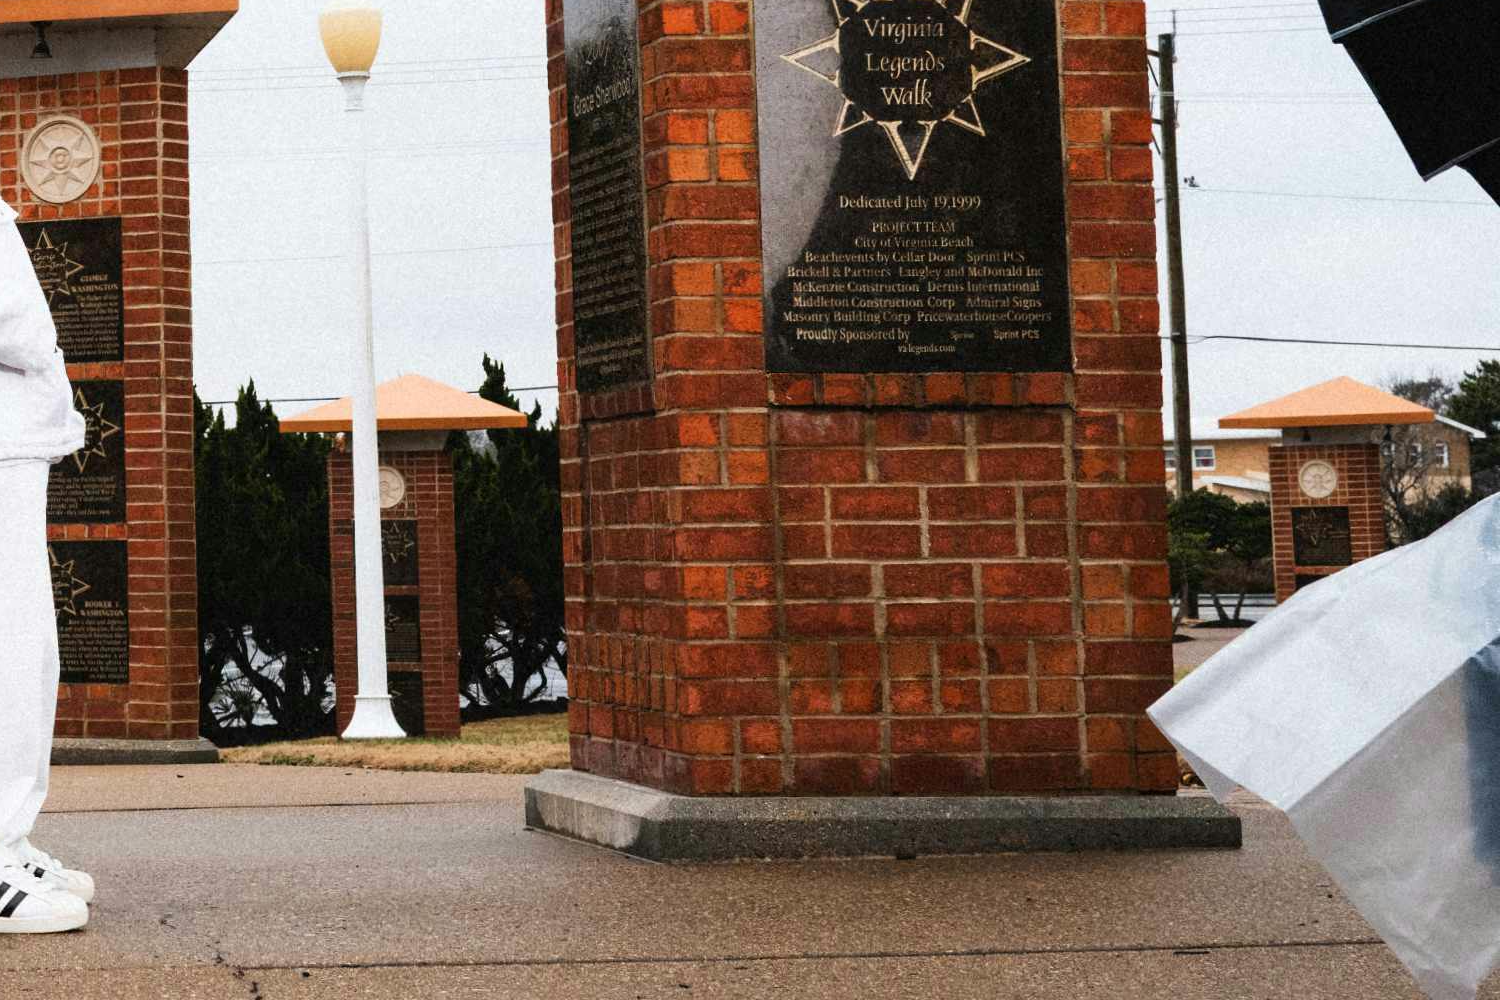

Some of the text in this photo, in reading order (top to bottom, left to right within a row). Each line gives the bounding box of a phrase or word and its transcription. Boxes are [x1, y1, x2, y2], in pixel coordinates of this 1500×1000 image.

[864, 16, 945, 45] Virginia
[865, 50, 946, 79] Legends
[880, 79, 933, 108] Walk
[573, 92, 596, 117] Grace
[840, 195, 981, 210] Dedicated July 19,1999
[872, 221, 955, 233] PROJECT TEAM
[854, 236, 974, 250] City of Virginia Beach
[805, 250, 1026, 265] Beachevents by Cellar Door Sprint PCS
[787, 266, 830, 277] Brickell
[832, 267, 842, 277] &
[844, 266, 893, 277] Partners
[899, 266, 941, 280] Langley
[944, 266, 964, 277] and
[967, 266, 1023, 277] McDonald
[793, 281, 845, 292] McKenzie
[967, 281, 1041, 292] International
[793, 296, 849, 308] Middleton
[851, 296, 924, 308] Construction
[927, 296, 956, 310] Corp
[1012, 296, 1042, 310] Signs
[783, 311, 830, 323] Masonry
[833, 311, 880, 324] Building
[882, 311, 911, 325] Corp
[796, 328, 838, 343] Proudly
[840, 328, 894, 343] Sponsored
[898, 328, 910, 343] by
[993, 328, 1019, 340] Sprint
[1021, 329, 1041, 340] PCS
